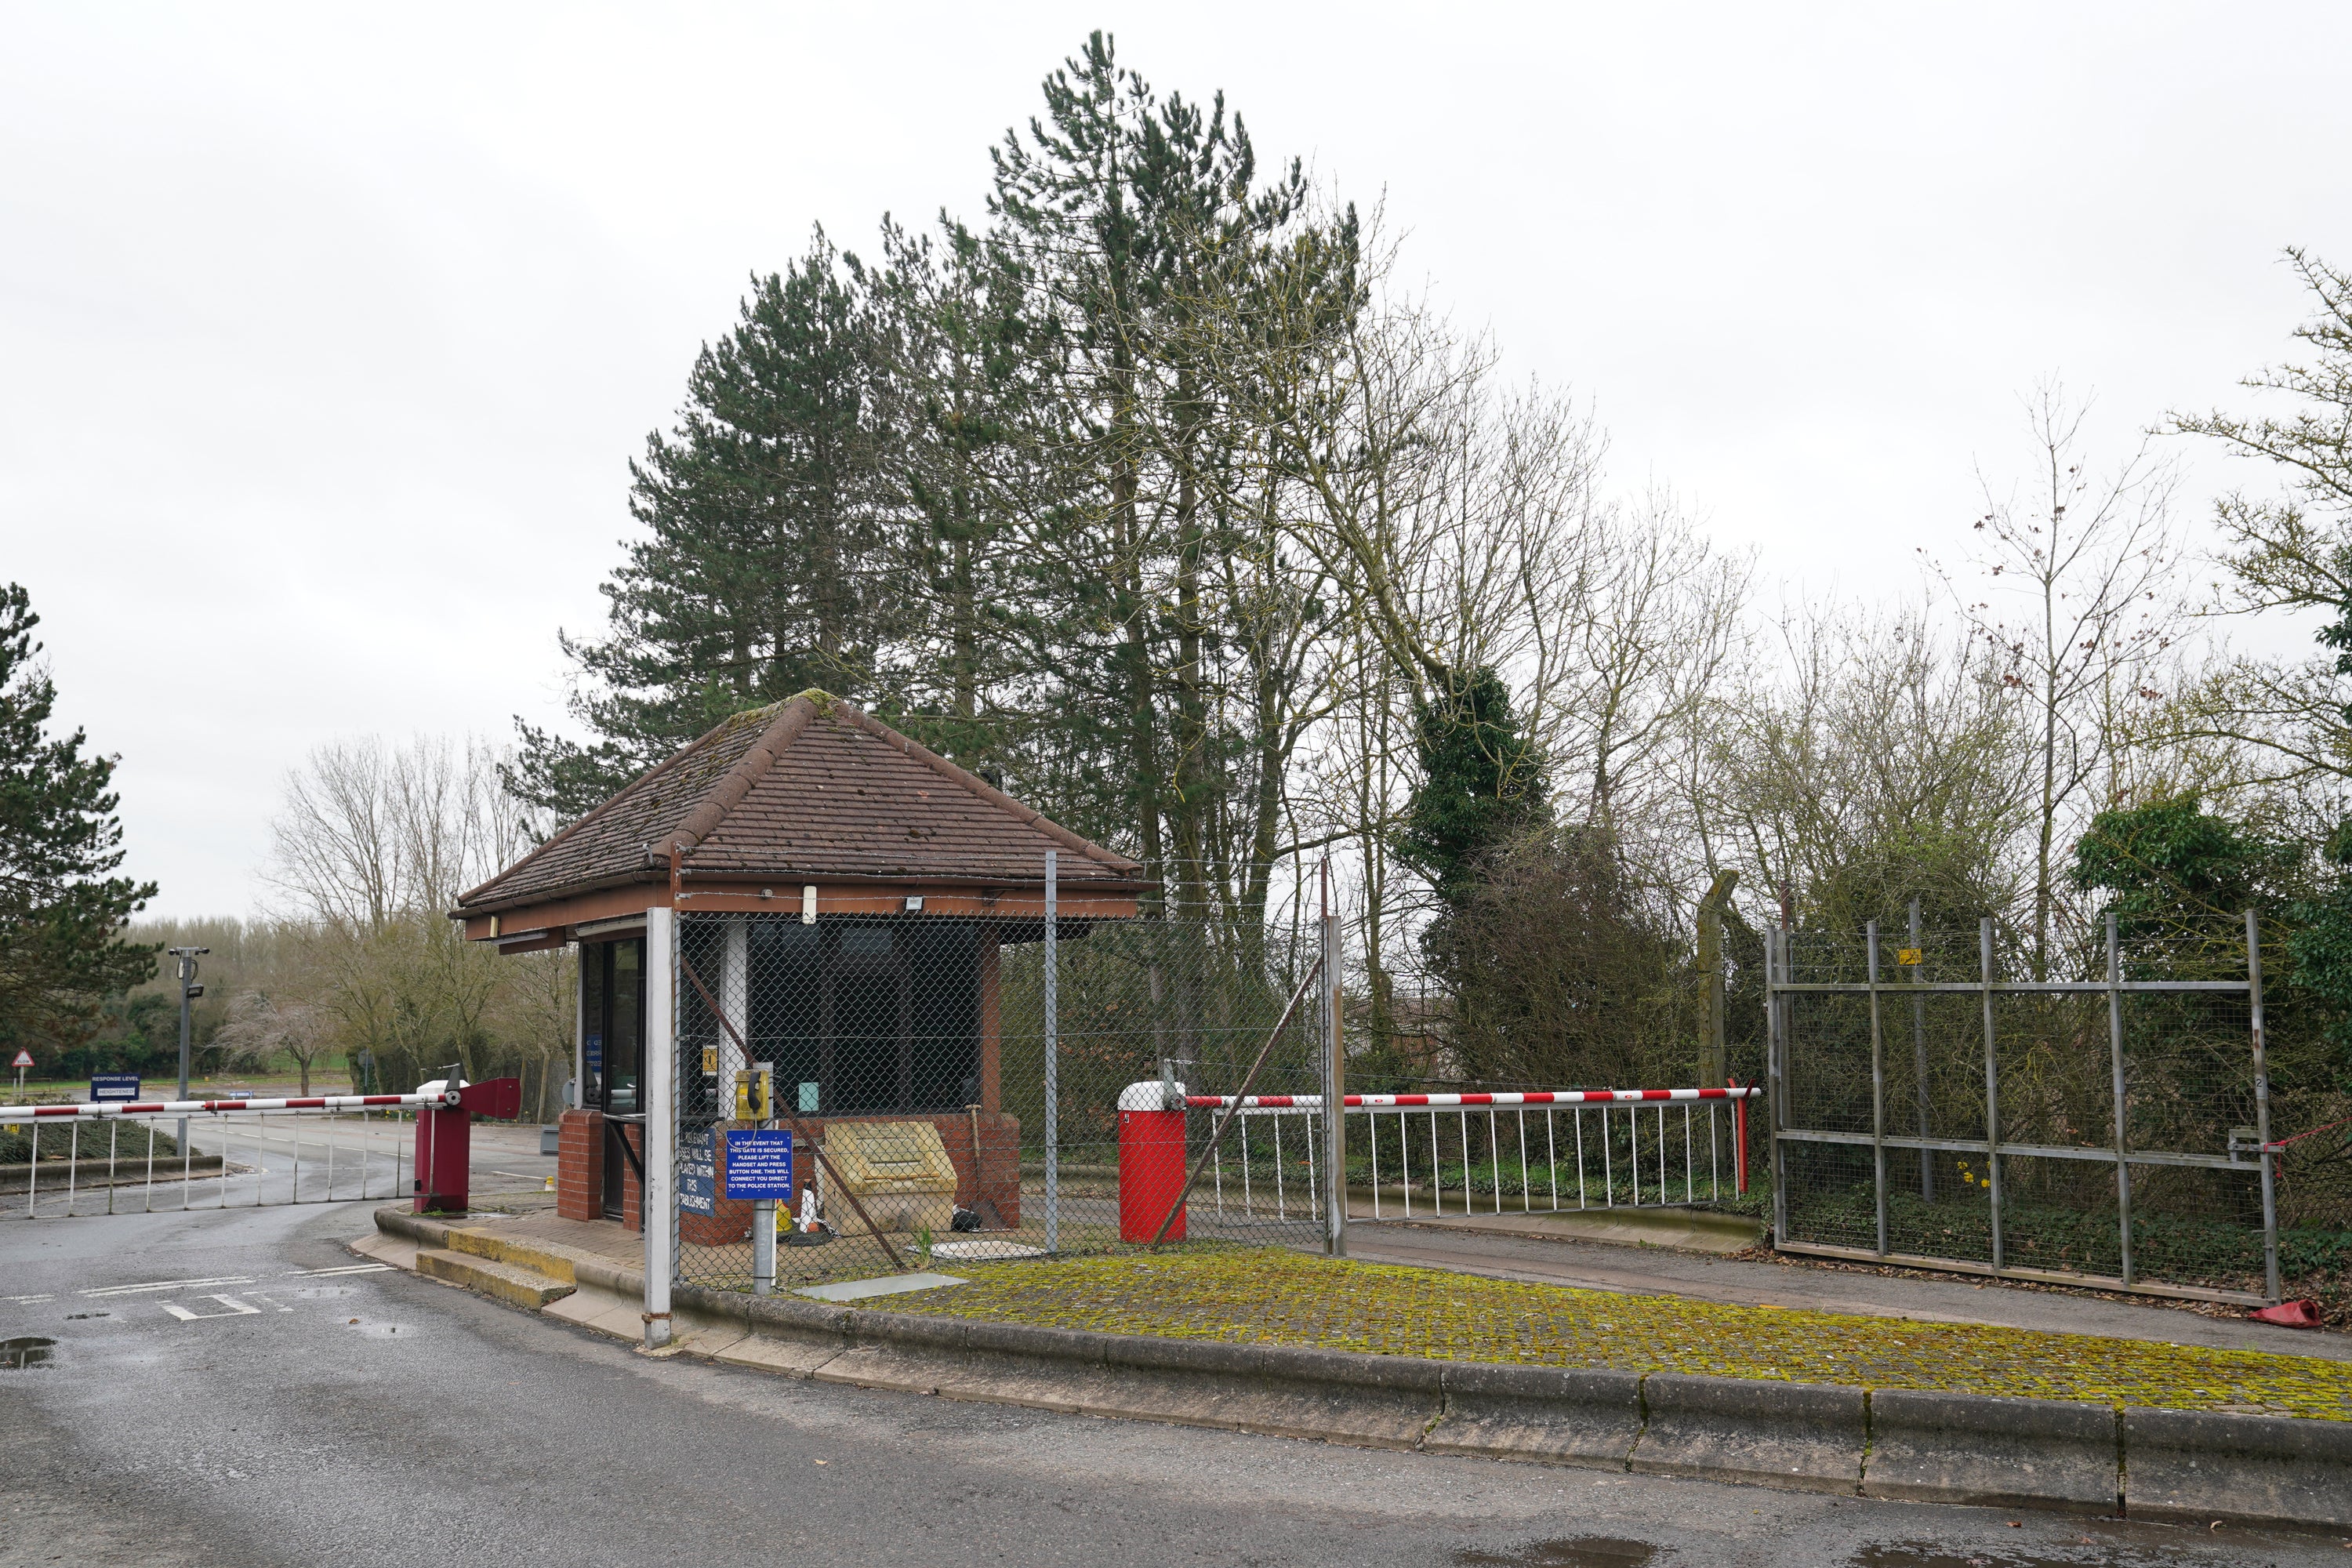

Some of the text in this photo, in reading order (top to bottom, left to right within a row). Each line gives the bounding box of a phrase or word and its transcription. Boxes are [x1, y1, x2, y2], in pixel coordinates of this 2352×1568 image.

[2256, 1078, 2262, 1087] 2
[691, 1148, 703, 1160] WILL
[704, 1149, 712, 1161] BE
[696, 1164, 714, 1178] WITHIN
[687, 1178, 697, 1192] THIS
